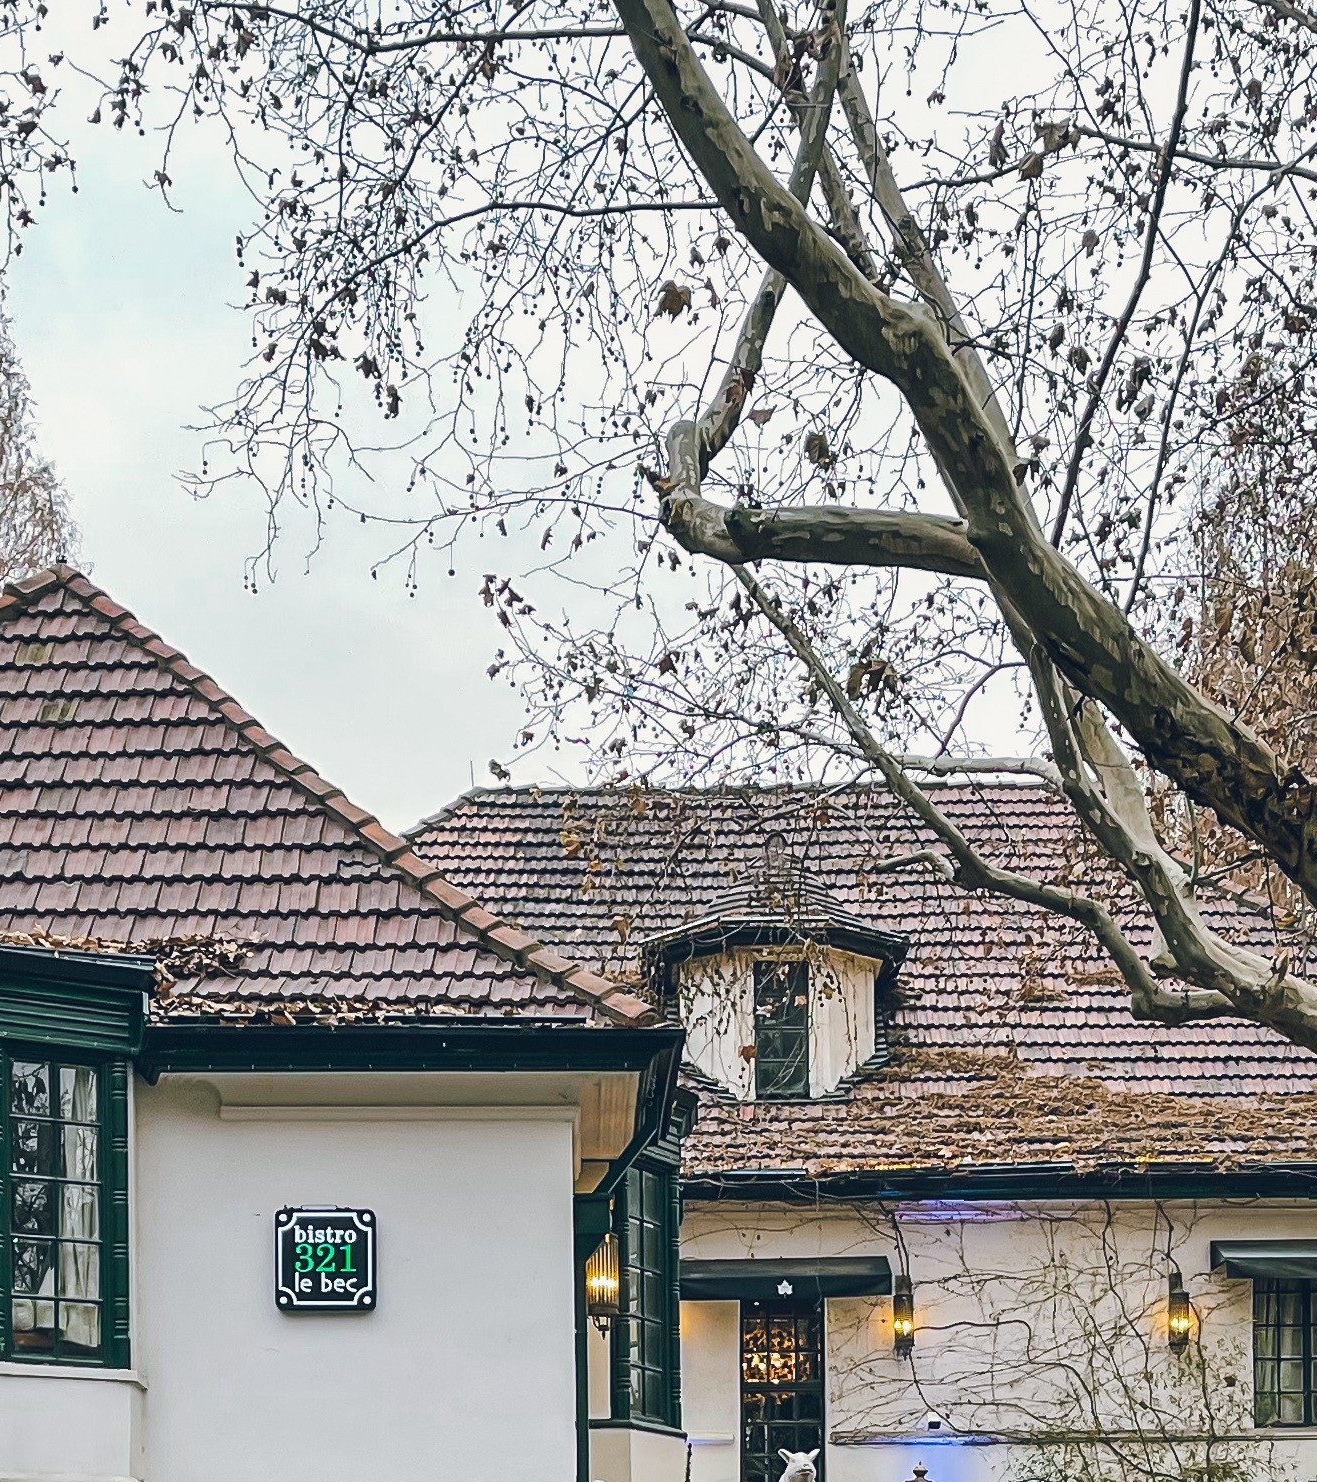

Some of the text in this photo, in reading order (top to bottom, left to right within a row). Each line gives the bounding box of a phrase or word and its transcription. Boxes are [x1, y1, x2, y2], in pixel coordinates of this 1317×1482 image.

[293, 1224, 357, 1243] bistro
[294, 1243, 357, 1272] 321
[294, 1272, 358, 1293] le bec
